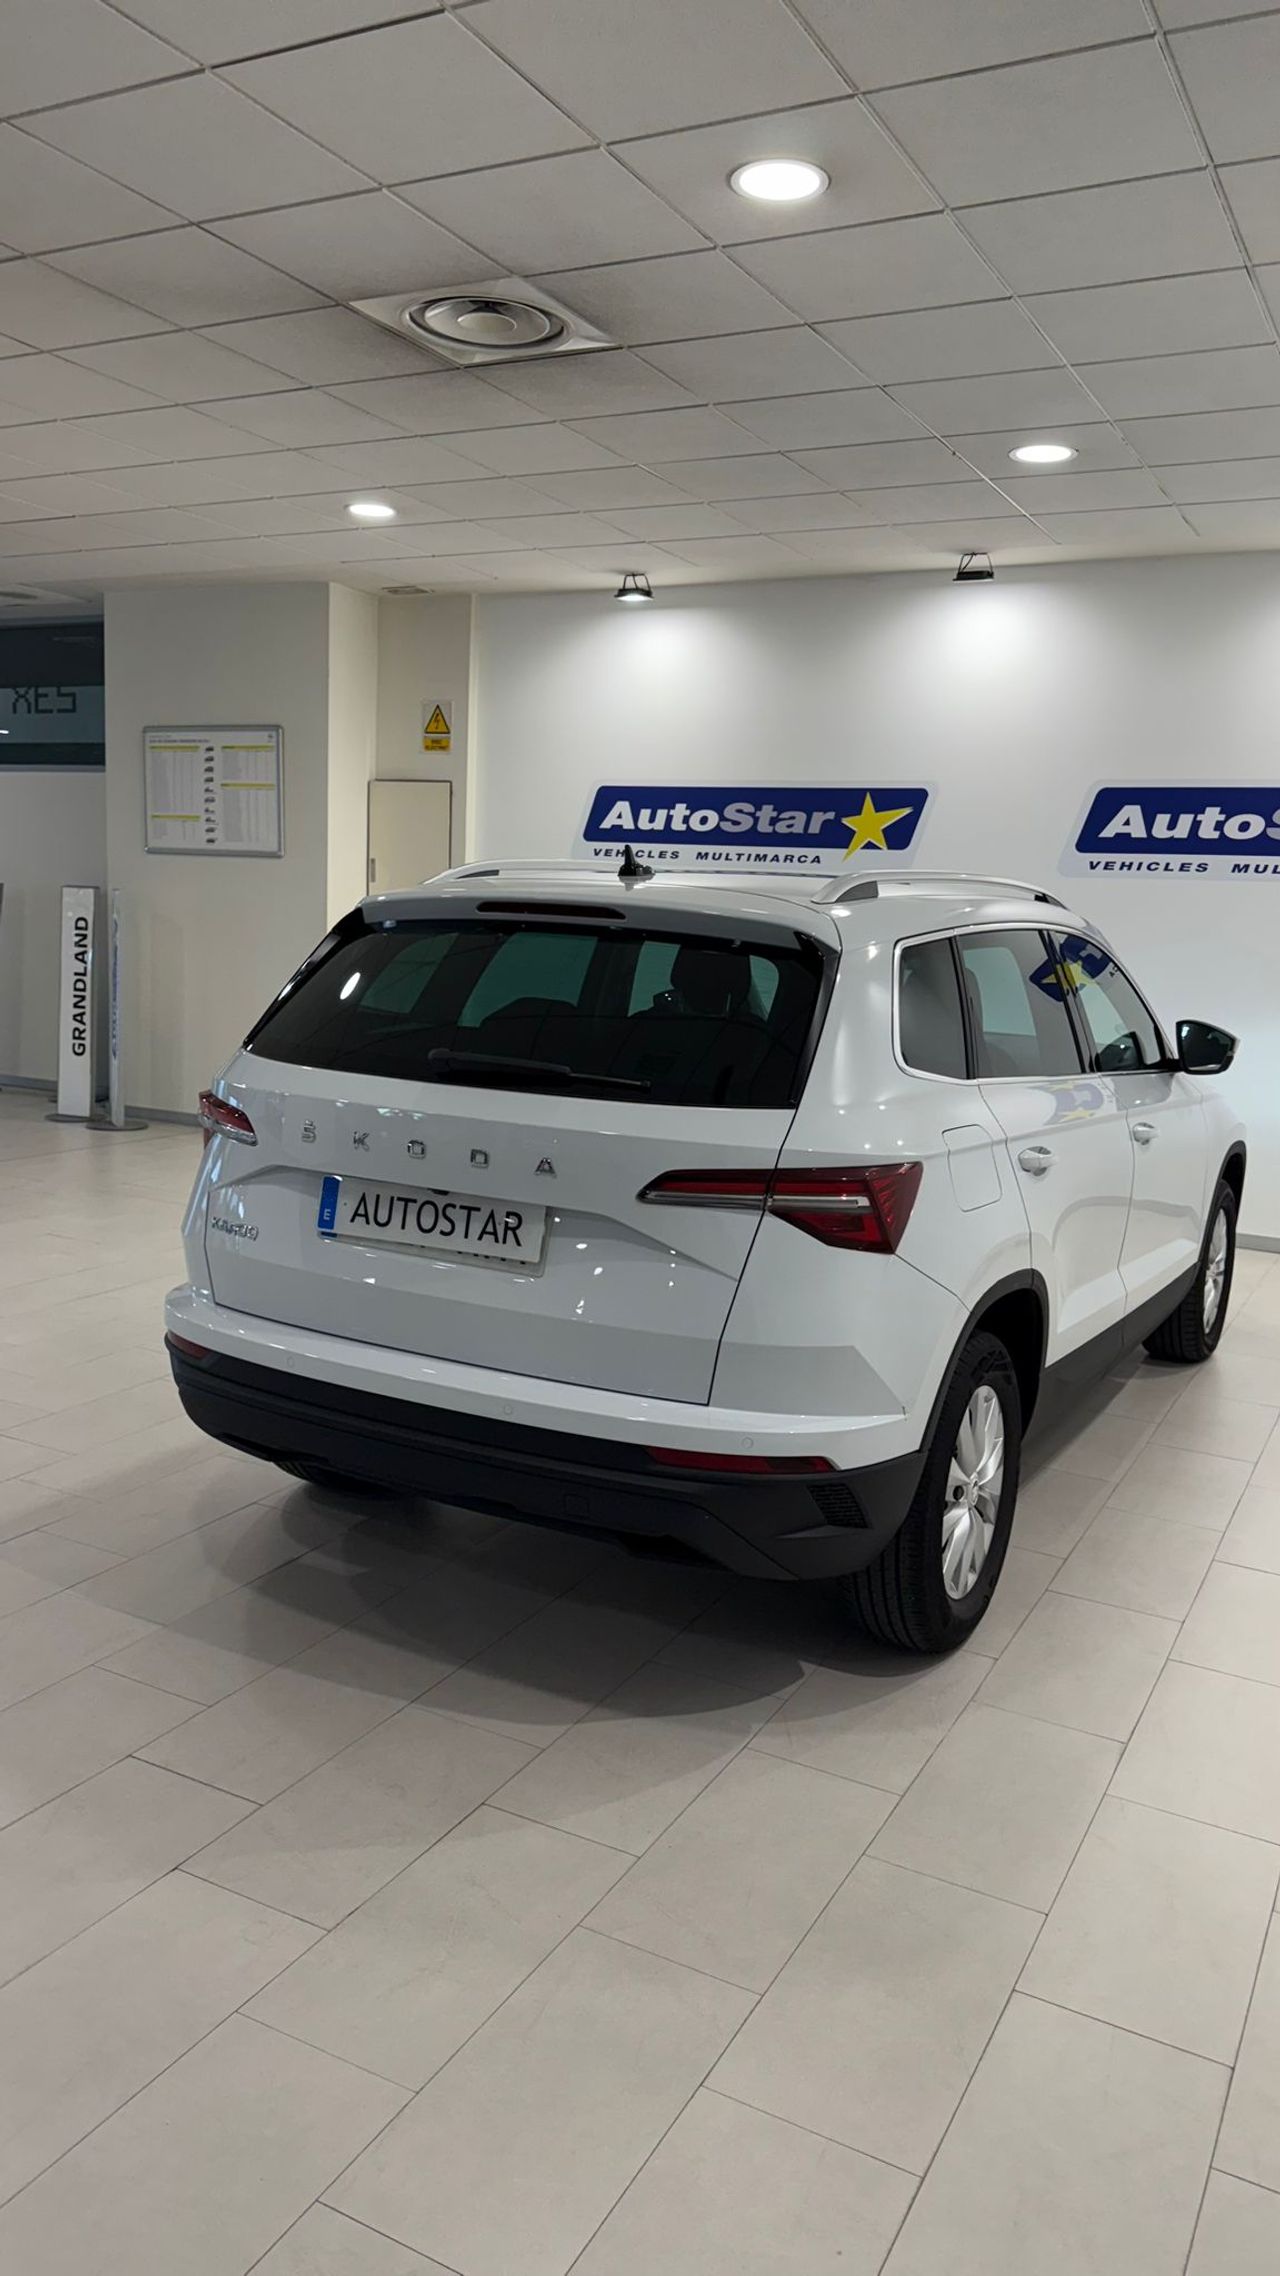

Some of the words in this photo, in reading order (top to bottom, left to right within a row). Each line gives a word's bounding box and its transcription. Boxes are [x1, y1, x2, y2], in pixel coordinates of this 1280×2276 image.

[598, 801, 836, 834] AutoStar
[593, 848, 680, 860] VEHCLES
[695, 851, 822, 865] MULTIMARCA
[1089, 861, 1209, 873] VEHICLES
[72, 916, 89, 1057] GRANDLAND
[323, 1208, 332, 1221] E
[350, 1192, 523, 1247] AUTOSTAR
